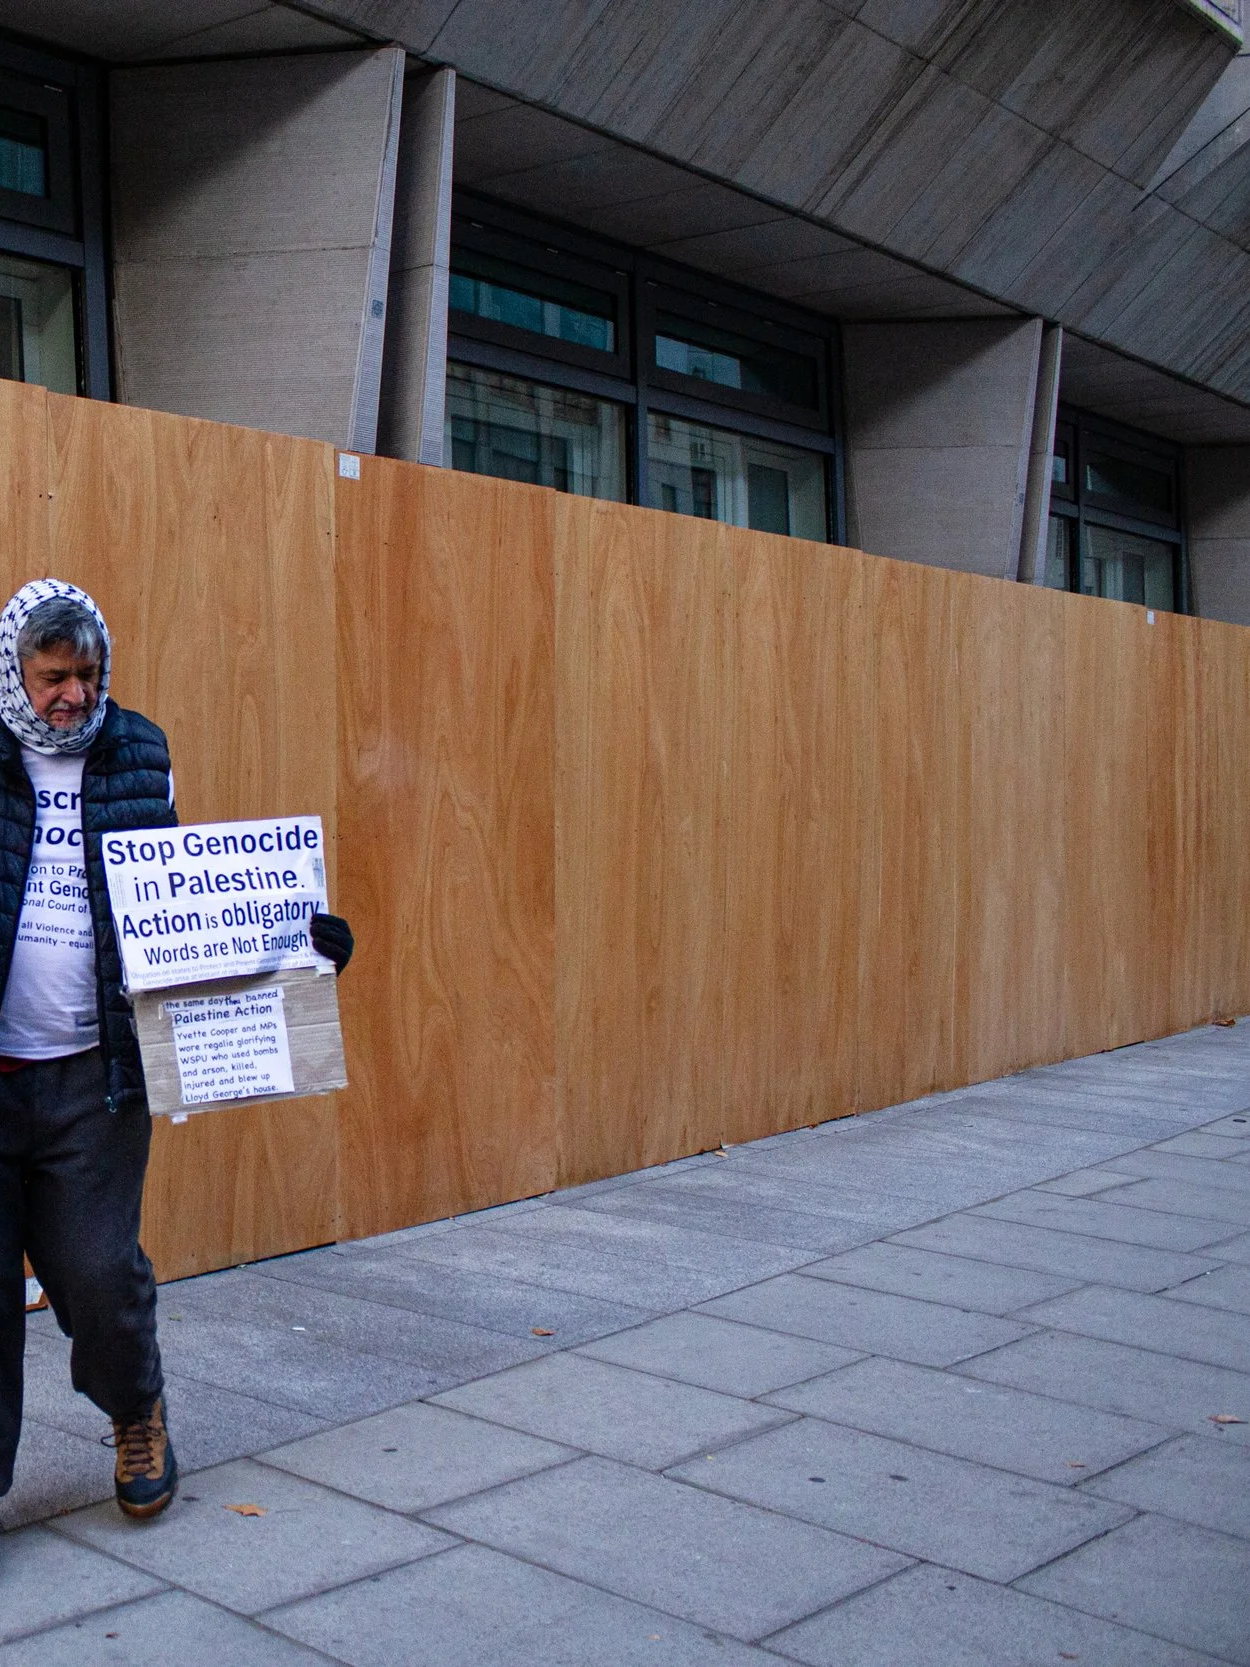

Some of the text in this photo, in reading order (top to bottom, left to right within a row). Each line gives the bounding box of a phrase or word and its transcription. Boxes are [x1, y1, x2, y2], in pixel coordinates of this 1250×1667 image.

[108, 825, 318, 865] Stop Genocide
[52, 864, 64, 876] to
[135, 877, 159, 902] in
[168, 866, 305, 898] Palestine.
[47, 901, 76, 912] Court
[78, 904, 87, 913] of
[123, 899, 320, 939] Action is obligatory
[21, 921, 94, 937] all Violence and
[144, 930, 308, 966] Words are Not Enough
[166, 1001, 179, 1009] the
[184, 999, 204, 1007] same
[208, 997, 224, 1006] day
[246, 991, 278, 1003] banned
[174, 1004, 272, 1025] Palestine Action
[177, 1031, 206, 1040] Yvette
[211, 1027, 238, 1038] Cooper
[242, 1025, 256, 1033] and
[179, 1035, 276, 1052] wore regalia glorifying
[180, 1055, 208, 1064] WSPU
[254, 1047, 278, 1055] bombs
[184, 1079, 215, 1089] injured
[238, 1072, 257, 1081] blew
[261, 1072, 270, 1081] up
[185, 1093, 208, 1103] Lloyd
[254, 1085, 278, 1093] house.
